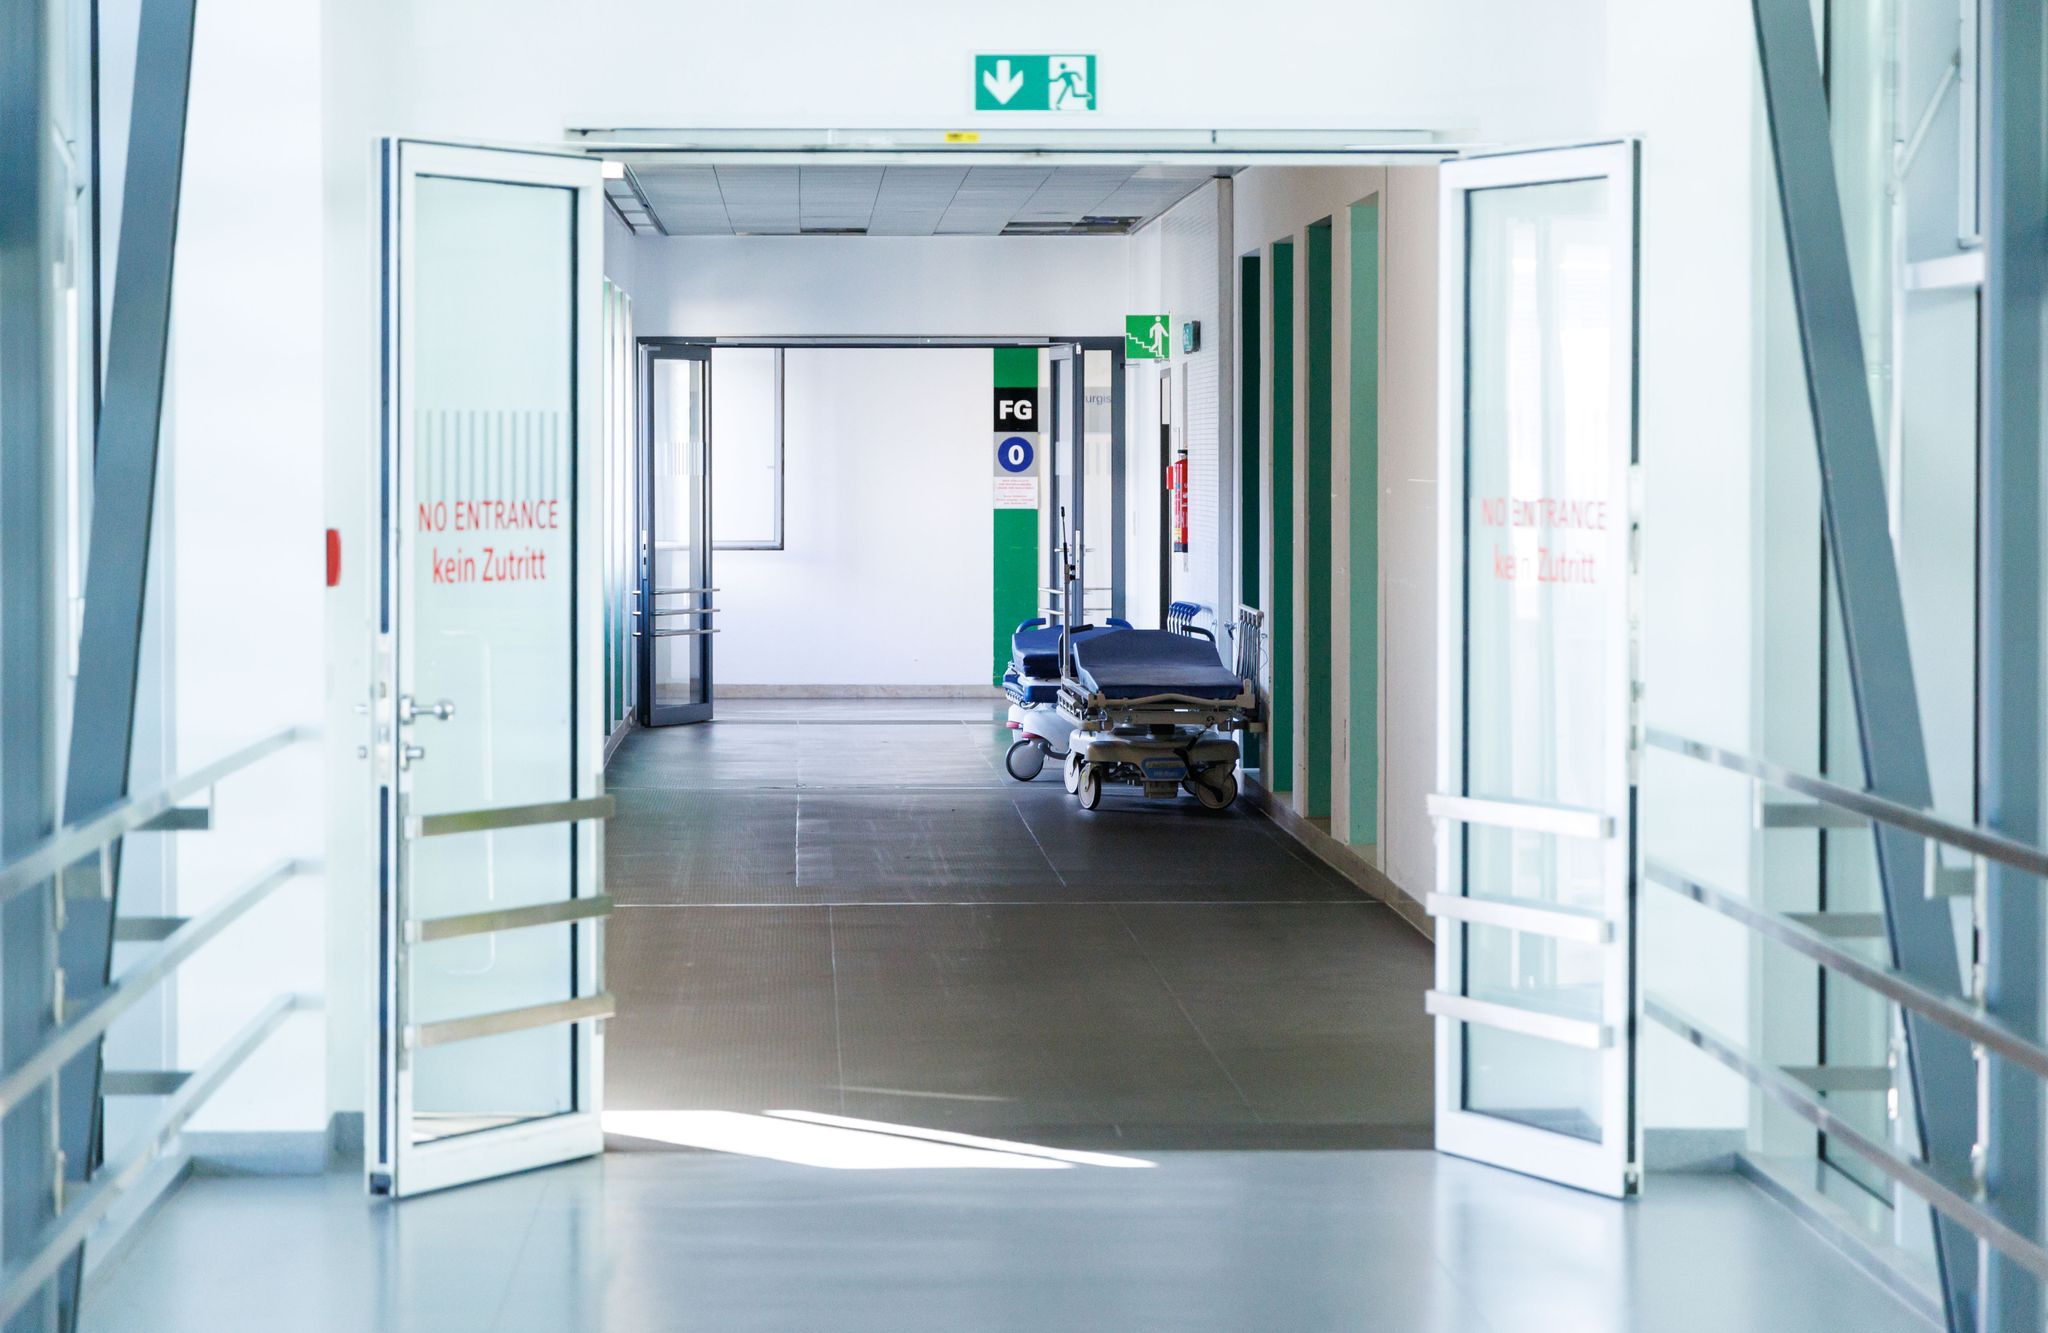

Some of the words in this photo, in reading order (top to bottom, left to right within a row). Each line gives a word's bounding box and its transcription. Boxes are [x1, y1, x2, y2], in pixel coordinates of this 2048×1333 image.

[999, 399, 1032, 420] FG
[1008, 445, 1024, 465] 0
[419, 501, 447, 531] NO
[455, 499, 558, 531] ENTRANCE
[1481, 498, 1506, 527] NO
[1512, 498, 1607, 531] ENTRANCE
[433, 546, 476, 583] kein
[483, 546, 546, 582] Zutritt
[1494, 544, 1530, 580] ken
[1537, 547, 1595, 583] Zutritt
